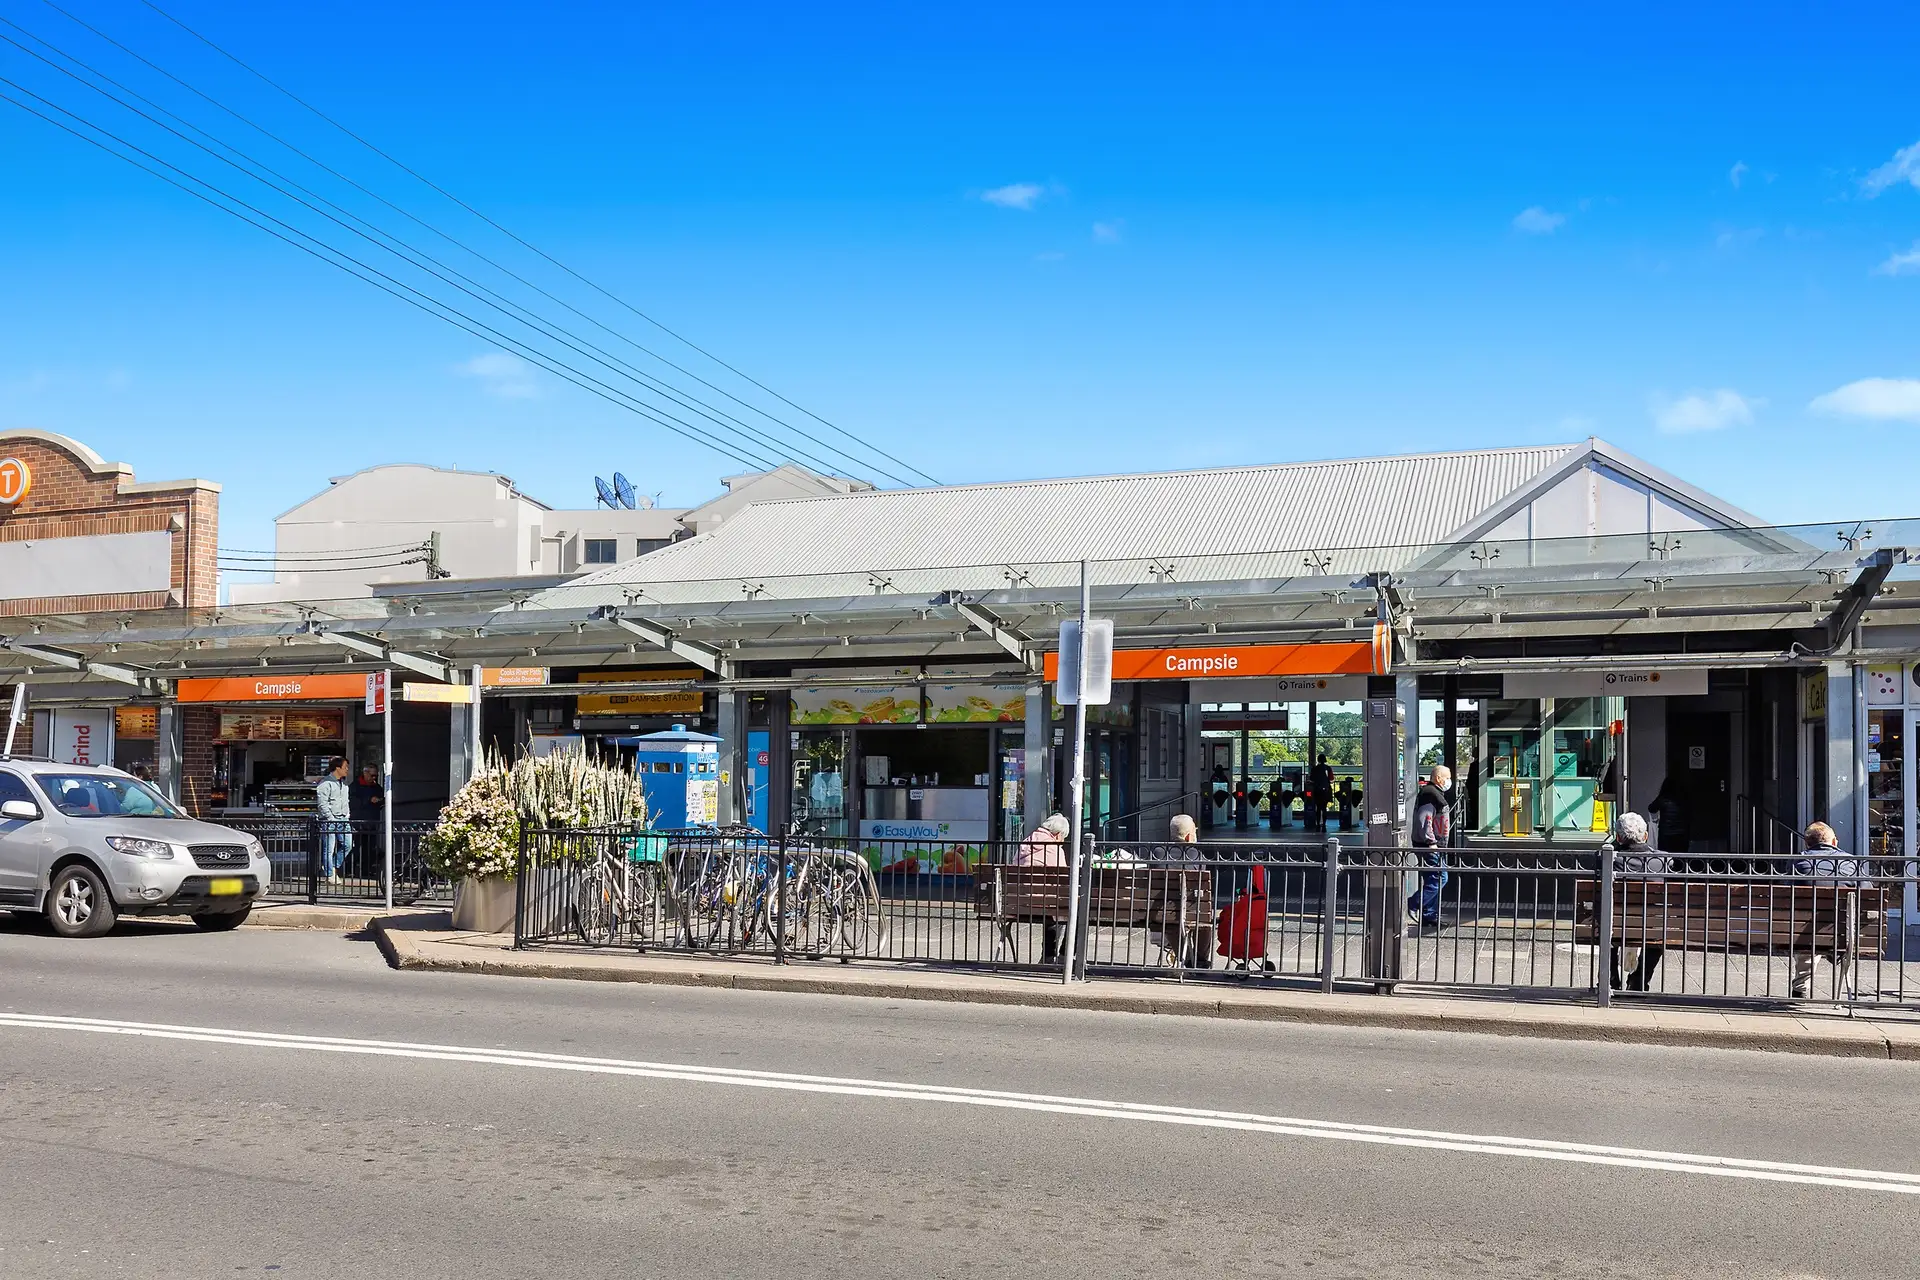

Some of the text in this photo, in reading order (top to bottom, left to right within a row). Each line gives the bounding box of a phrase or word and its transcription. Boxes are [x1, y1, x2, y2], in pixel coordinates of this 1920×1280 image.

[1, 469, 15, 494] T
[1165, 653, 1239, 674] Campsie
[1618, 673, 1648, 683] Trains
[255, 680, 302, 697] Campsie
[1289, 680, 1316, 690] Trains
[629, 694, 662, 703] CAMPSIE
[663, 693, 695, 702] STATION
[758, 755, 768, 763] 4G
[885, 825, 939, 840] EasyWay
